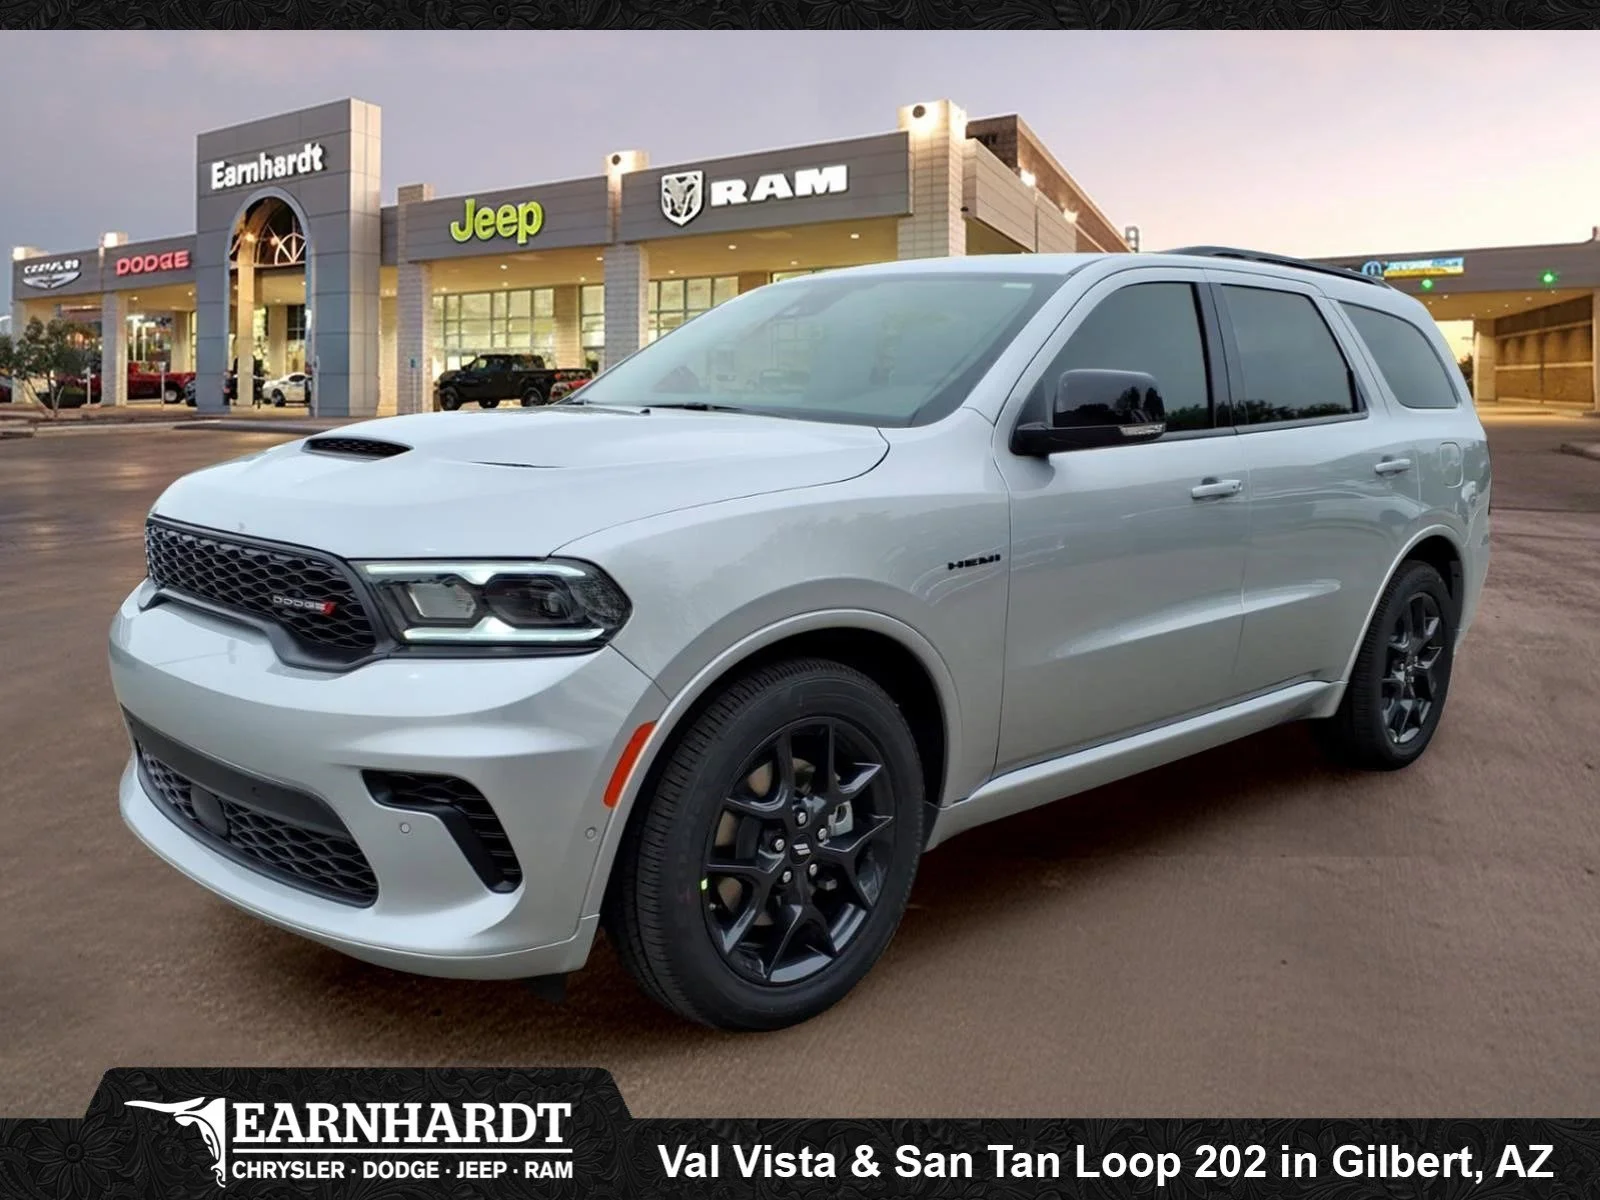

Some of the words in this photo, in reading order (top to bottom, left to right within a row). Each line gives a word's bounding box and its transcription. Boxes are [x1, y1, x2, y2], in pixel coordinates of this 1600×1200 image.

[211, 143, 323, 190] Earnhardt
[711, 164, 848, 207] RAM
[450, 198, 543, 244] Jeep
[115, 250, 190, 276] DODGE
[947, 554, 1001, 570] HEMI
[273, 595, 326, 611] DODGE
